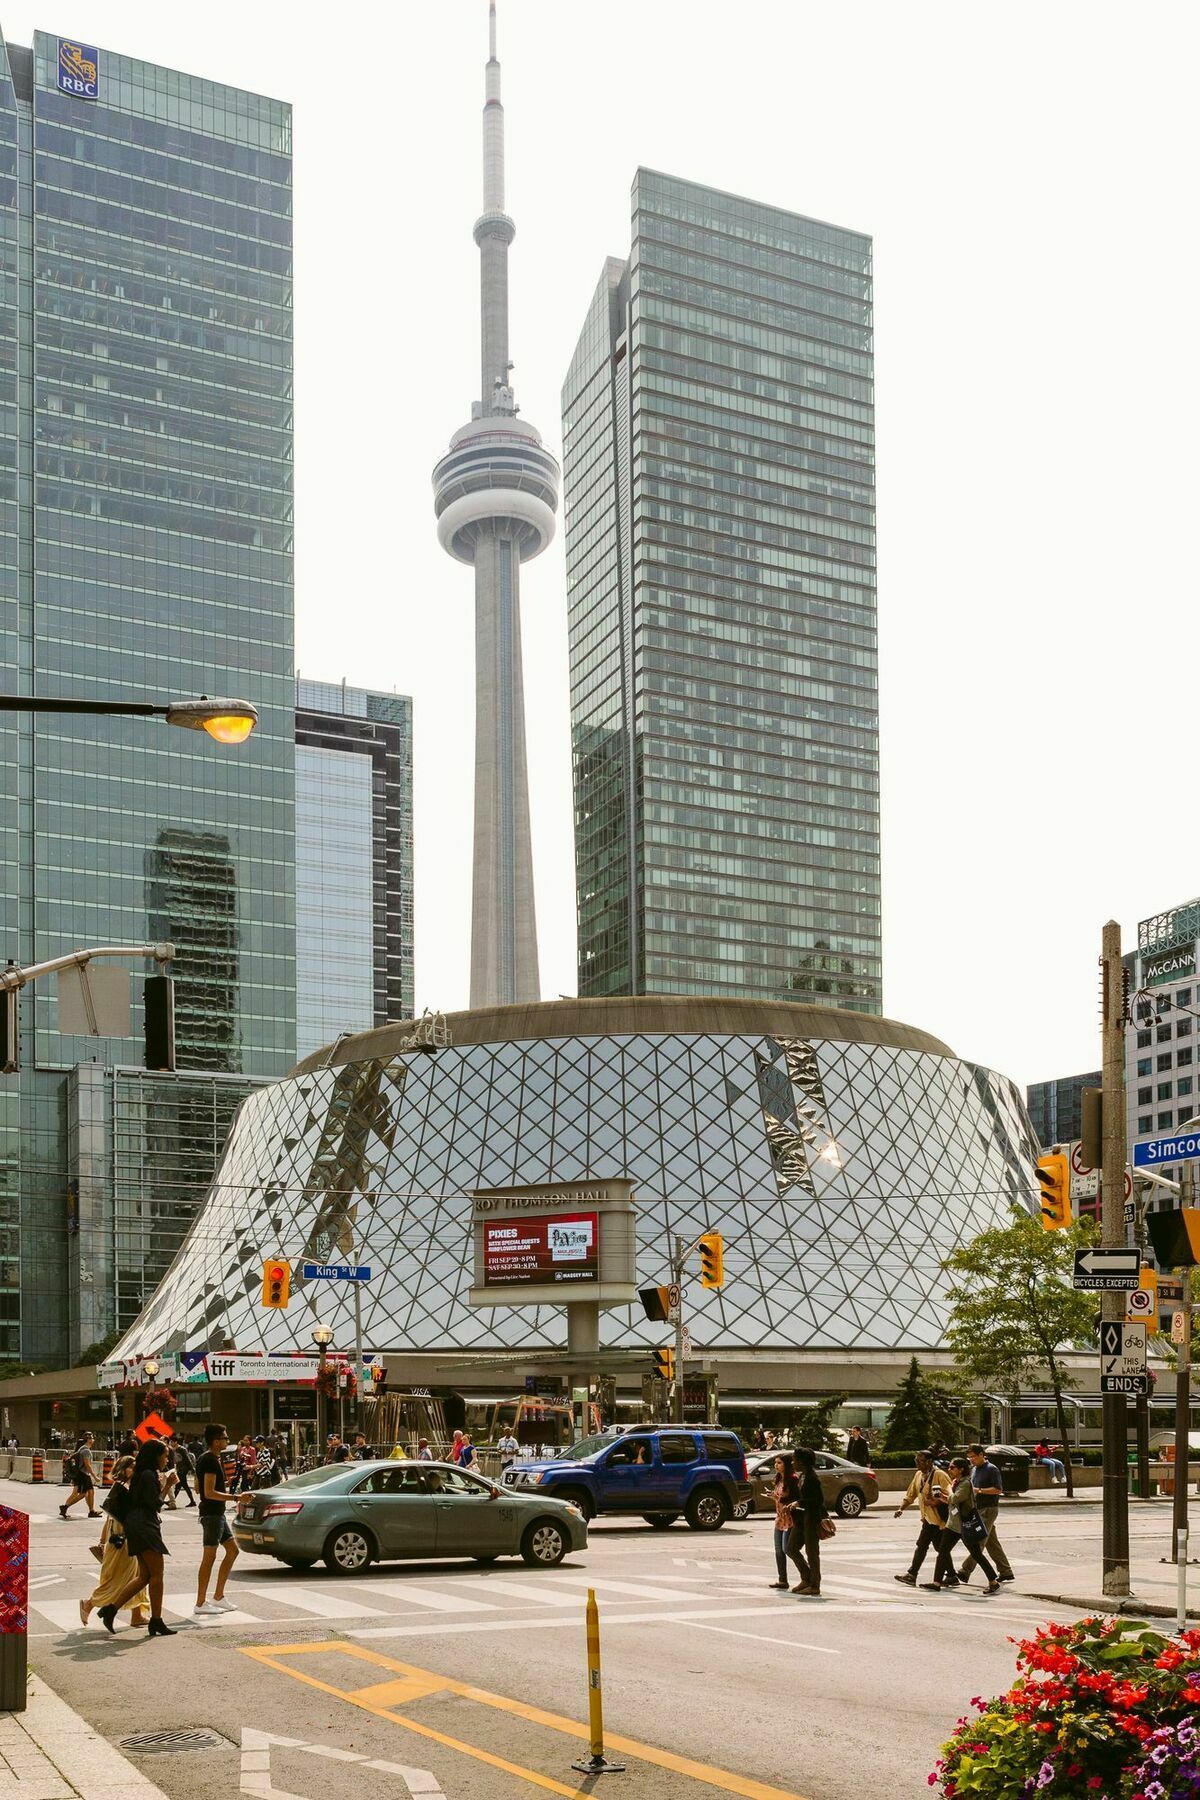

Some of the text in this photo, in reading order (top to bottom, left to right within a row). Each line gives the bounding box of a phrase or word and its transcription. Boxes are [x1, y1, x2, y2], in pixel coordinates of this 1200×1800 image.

[62, 76, 95, 96] RBC
[1147, 953, 1197, 978] McCANN
[474, 1199, 498, 1210] ROY
[503, 1194, 571, 1208] THOMSON
[488, 1229, 518, 1239] PIXIES
[316, 1266, 338, 1278] King
[349, 1267, 358, 1277] W
[1074, 1279, 1139, 1288] BICYCLES EXCEPTED
[1170, 1288, 1176, 1297] W
[211, 1360, 235, 1376] tiff
[1122, 1366, 1140, 1375] LANE
[1107, 1378, 1140, 1391] ENDS
[410, 1386, 430, 1396] VISA
